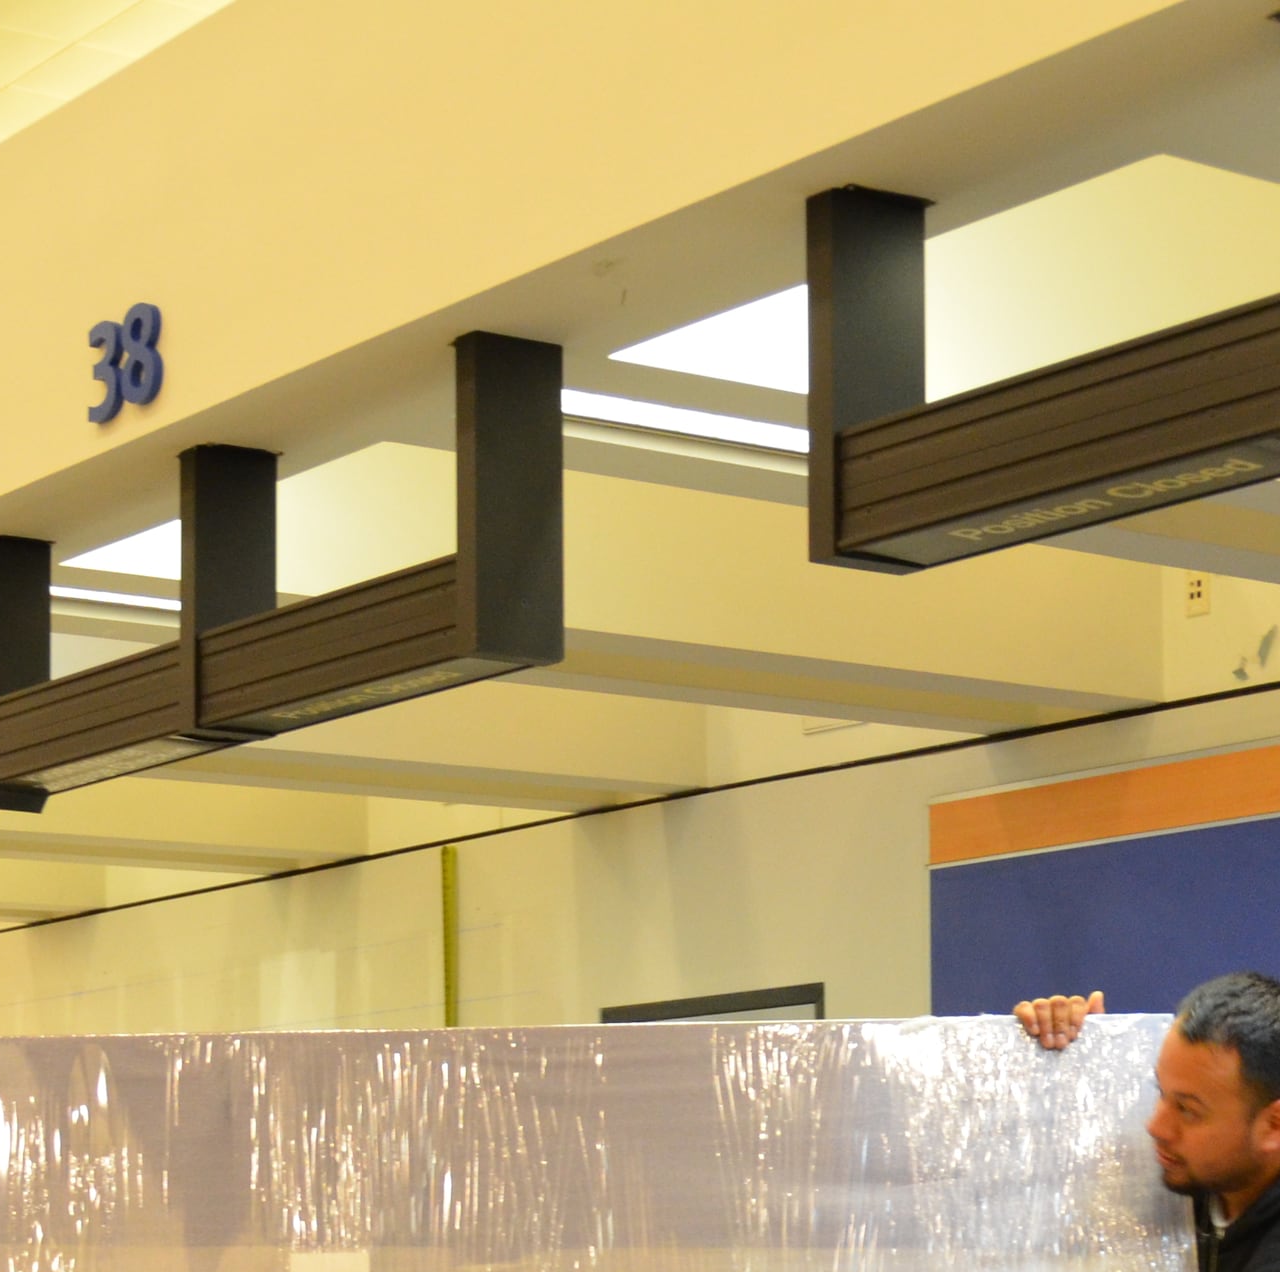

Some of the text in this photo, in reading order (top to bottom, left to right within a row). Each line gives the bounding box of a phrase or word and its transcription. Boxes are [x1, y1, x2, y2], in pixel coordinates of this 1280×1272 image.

[87, 302, 165, 424] 38
[948, 457, 1264, 541] Position Closed
